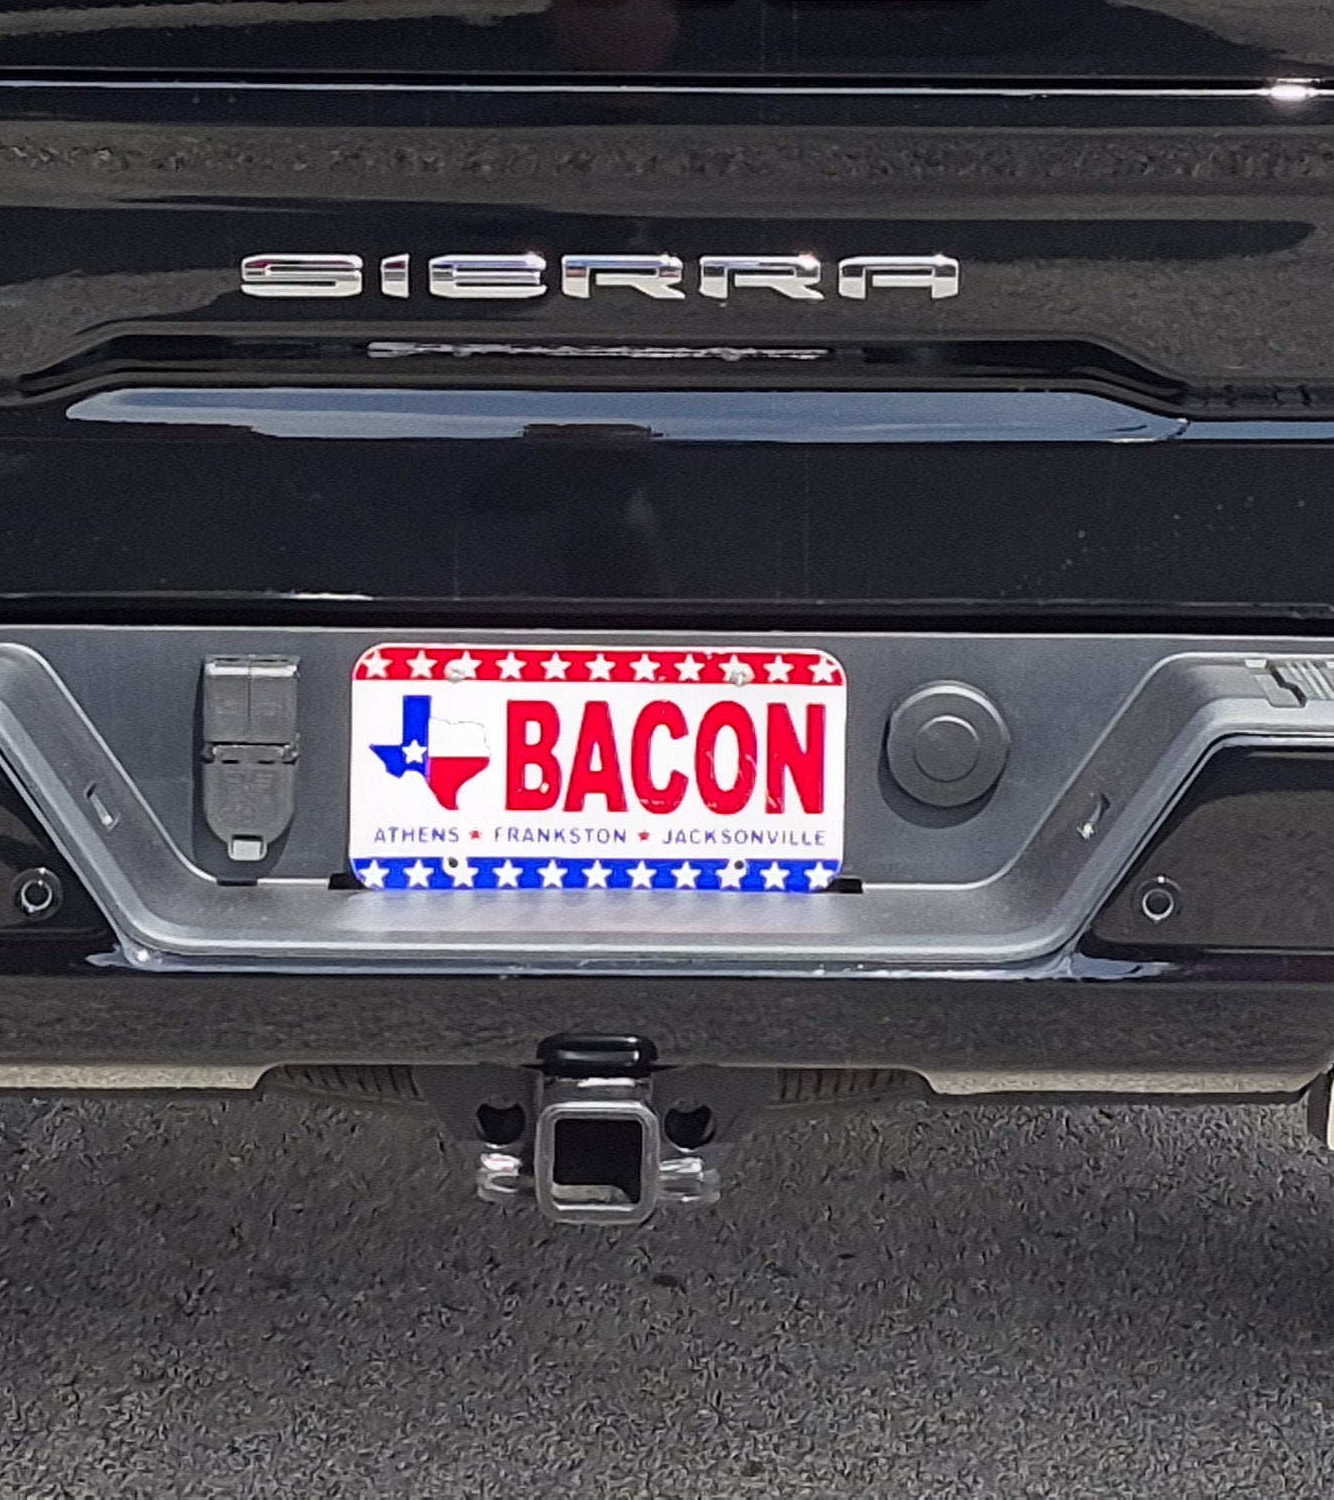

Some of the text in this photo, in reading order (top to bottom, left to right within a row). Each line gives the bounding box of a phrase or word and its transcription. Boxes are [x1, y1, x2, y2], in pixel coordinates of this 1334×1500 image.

[240, 252, 960, 301] SIERRA
[505, 699, 826, 814] BACON
[373, 826, 827, 847] ATHENS FRANKSTON JACKSONVILLE
